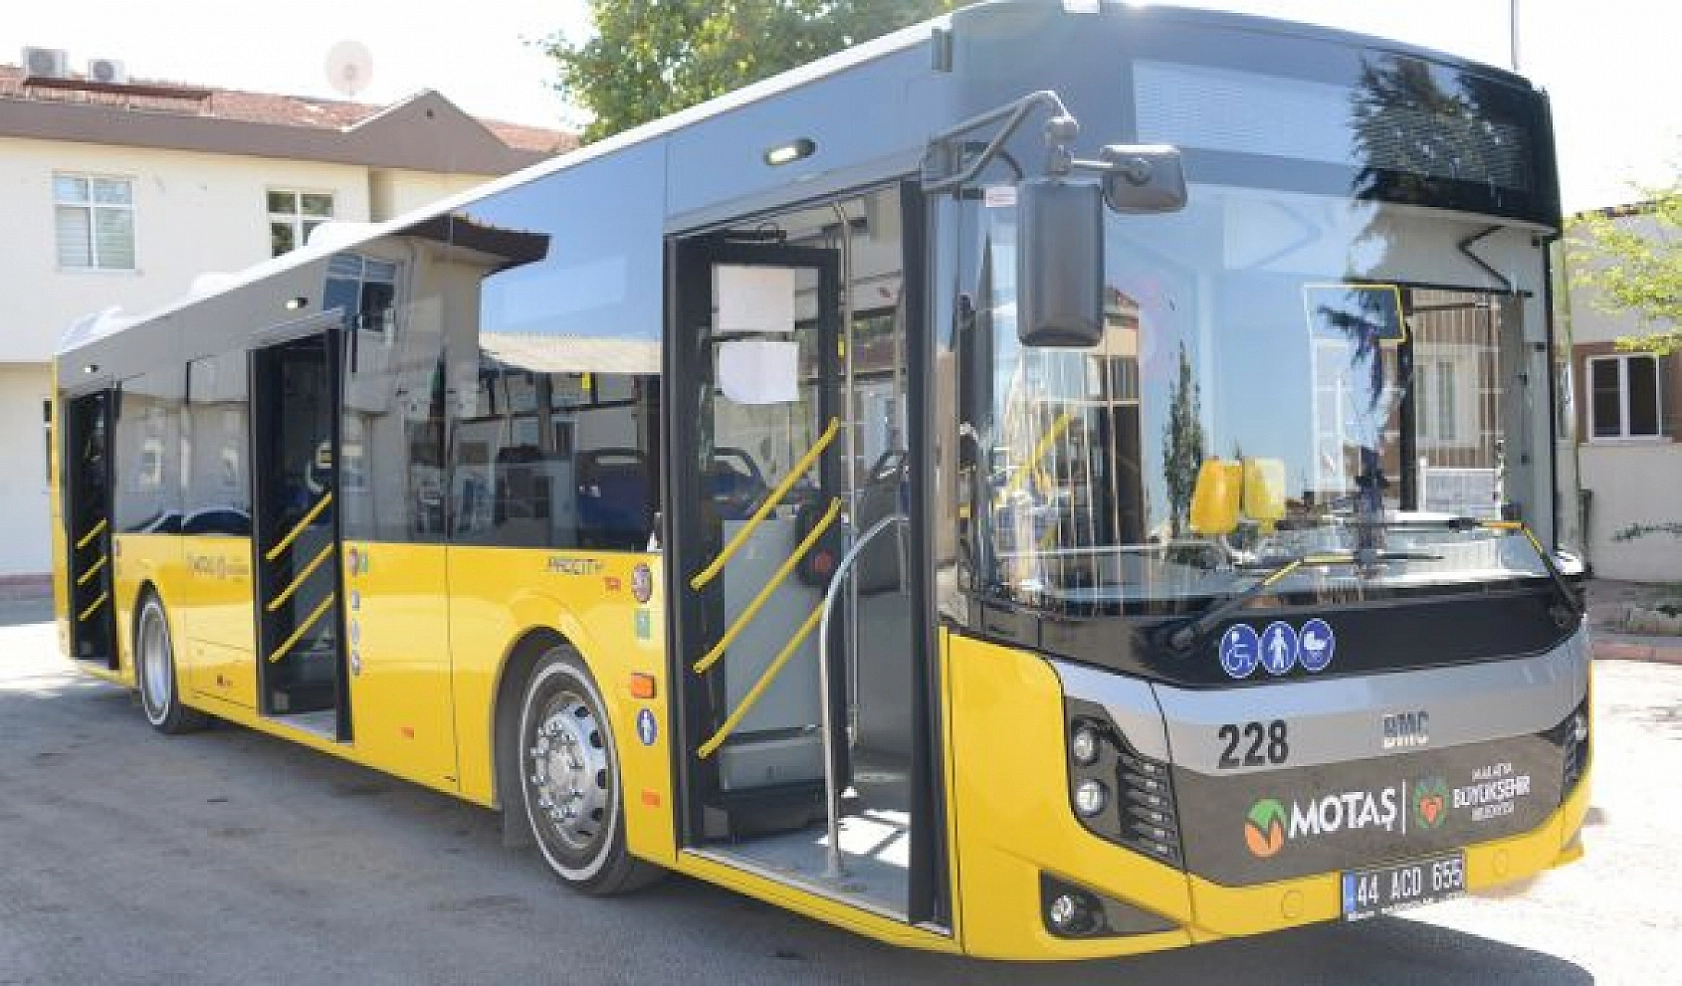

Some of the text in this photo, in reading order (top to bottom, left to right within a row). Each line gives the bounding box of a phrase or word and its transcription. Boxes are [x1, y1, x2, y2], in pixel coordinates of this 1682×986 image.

[1218, 719, 1289, 770] 228
[1383, 710, 1430, 748] BMC
[1287, 787, 1398, 838] MOTAŞ
[1357, 859, 1463, 906] 44 ACD 655
